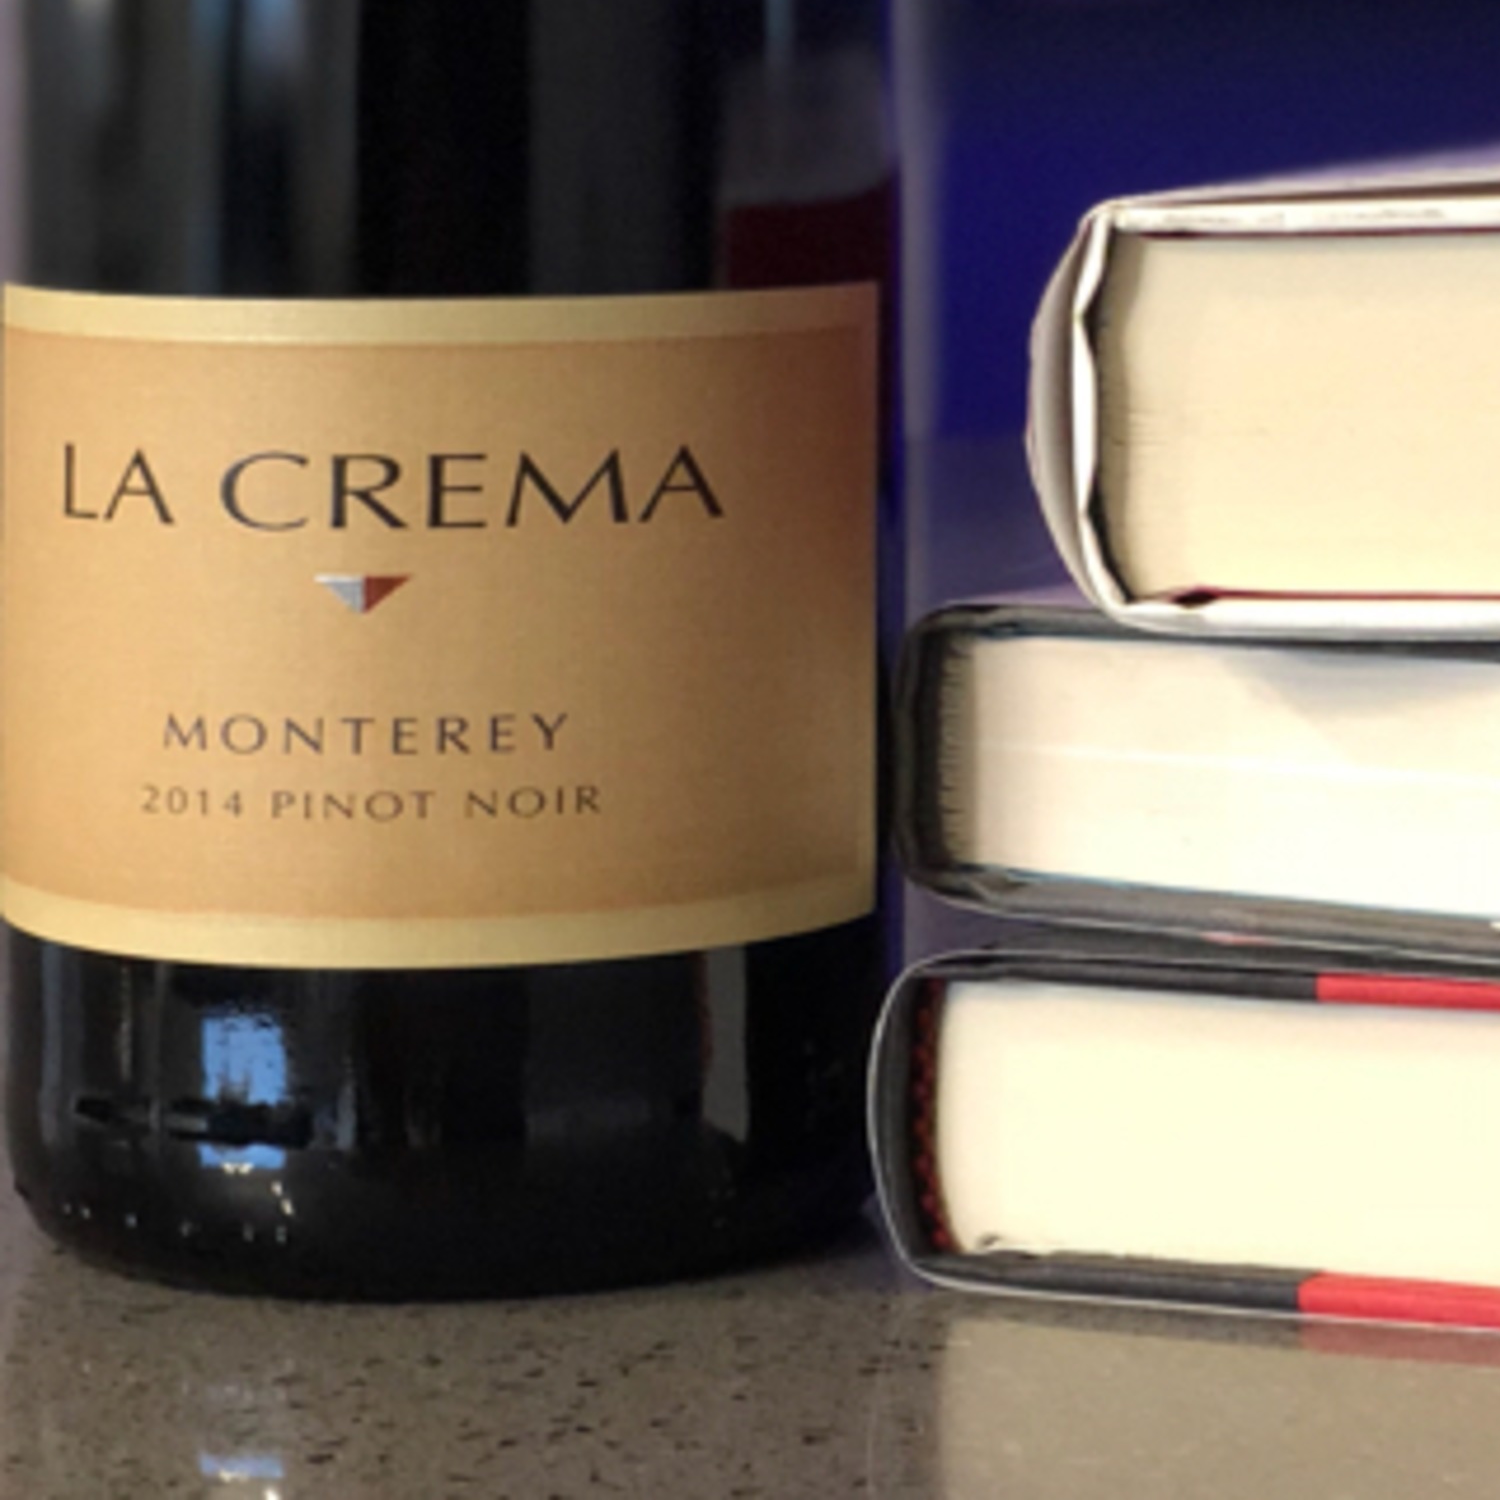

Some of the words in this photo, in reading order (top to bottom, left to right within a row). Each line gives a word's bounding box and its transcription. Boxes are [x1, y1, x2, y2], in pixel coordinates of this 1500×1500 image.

[61, 443, 175, 525] LA
[219, 444, 726, 532] CREMA
[162, 712, 571, 757] MONTEREY
[140, 784, 245, 820] 2014
[270, 790, 437, 823] PINOT
[464, 784, 602, 820] NOIR
